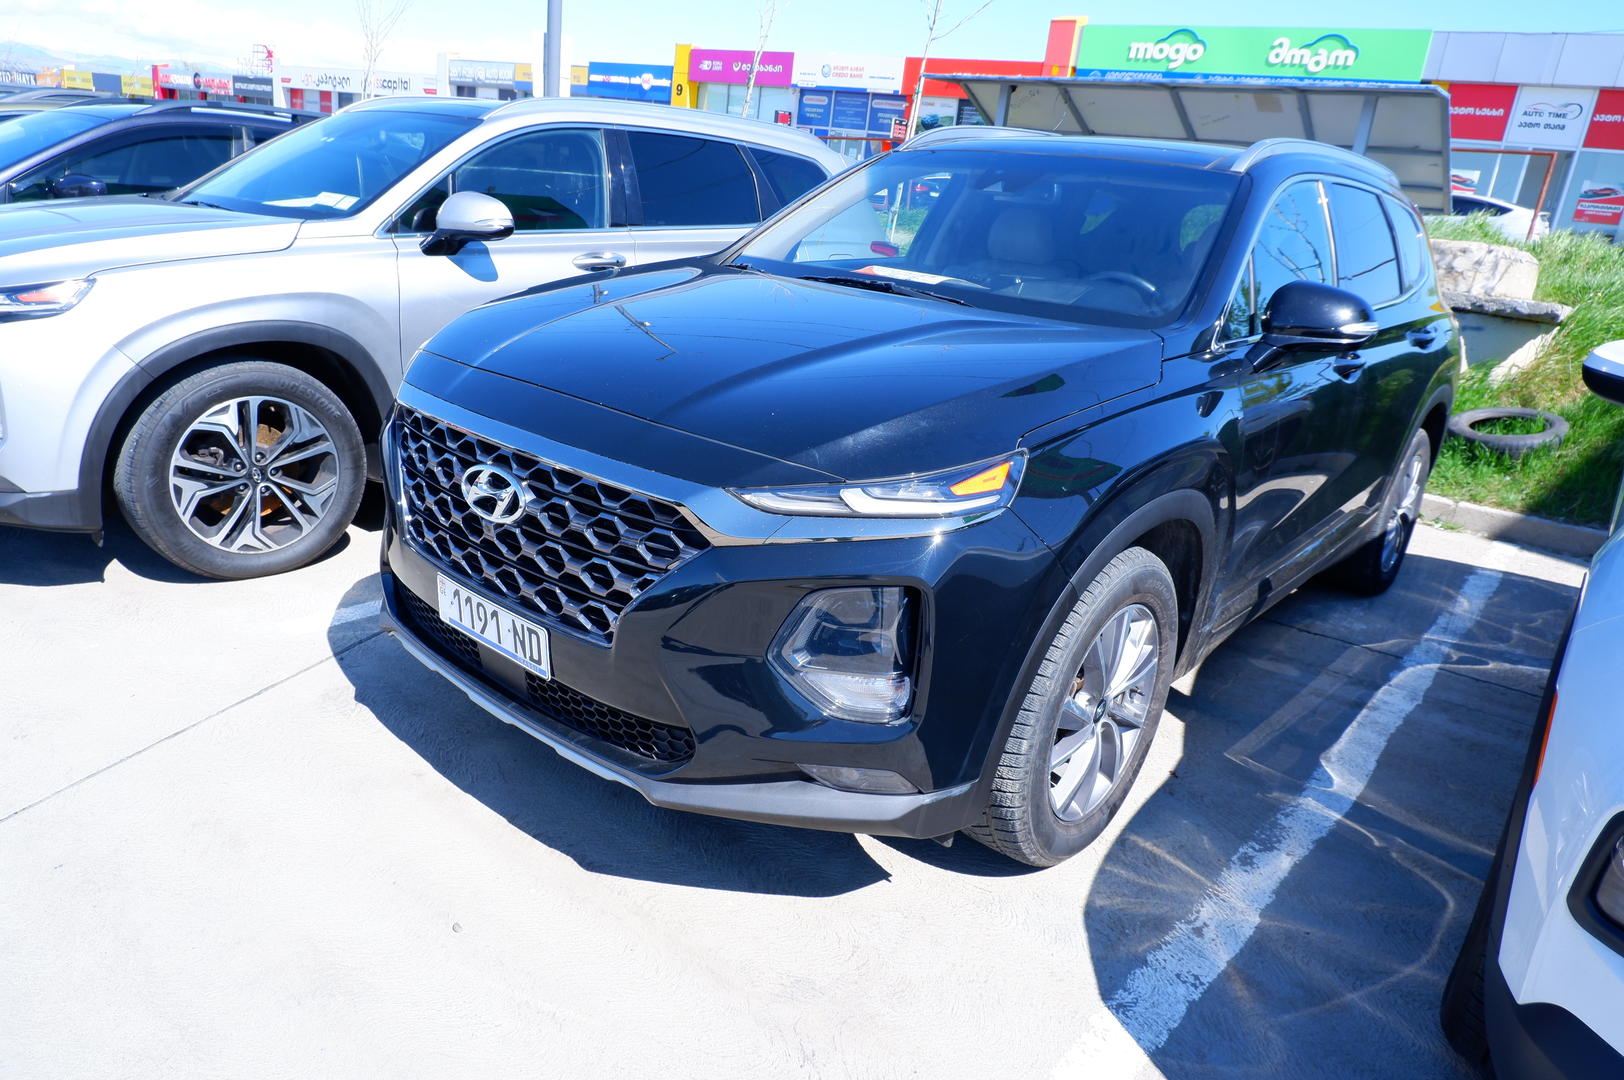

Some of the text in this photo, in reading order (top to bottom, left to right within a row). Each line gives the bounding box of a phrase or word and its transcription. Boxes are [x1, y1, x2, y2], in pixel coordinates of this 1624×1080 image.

[1128, 42, 1205, 69] mogo
[1268, 37, 1356, 73] მოგო
[741, 63, 783, 73] ტეაბანკი
[675, 84, 683, 96] 9
[1522, 110, 1569, 120] AUTO TIME
[453, 588, 542, 667] 1191 ND
